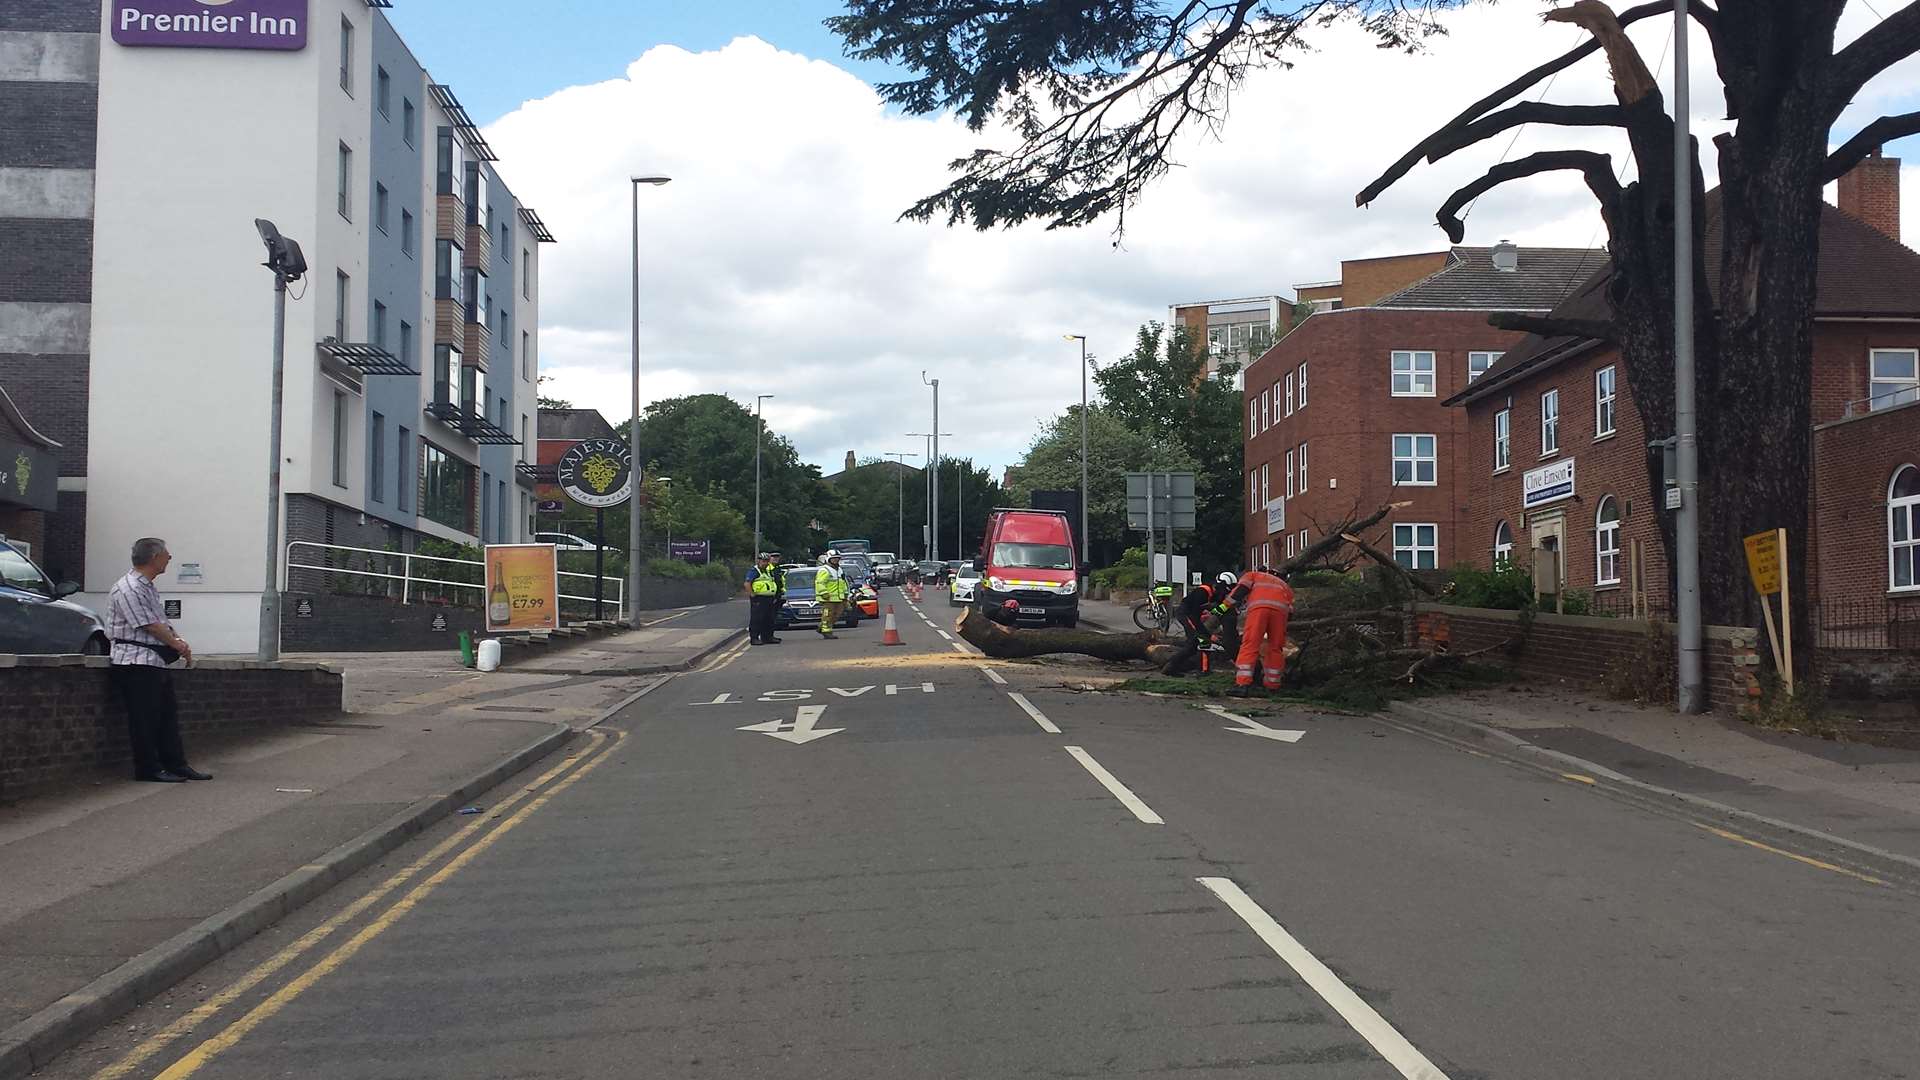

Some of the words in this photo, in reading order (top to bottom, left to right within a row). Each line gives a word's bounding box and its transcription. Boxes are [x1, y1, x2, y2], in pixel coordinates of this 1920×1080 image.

[121, 8, 244, 33] Premier
[250, 12, 297, 36] Inn
[560, 440, 631, 480] MAJESTIC
[1526, 473, 1542, 491] Clive
[1544, 468, 1567, 486] Emson
[513, 599, 544, 609] £7.99
